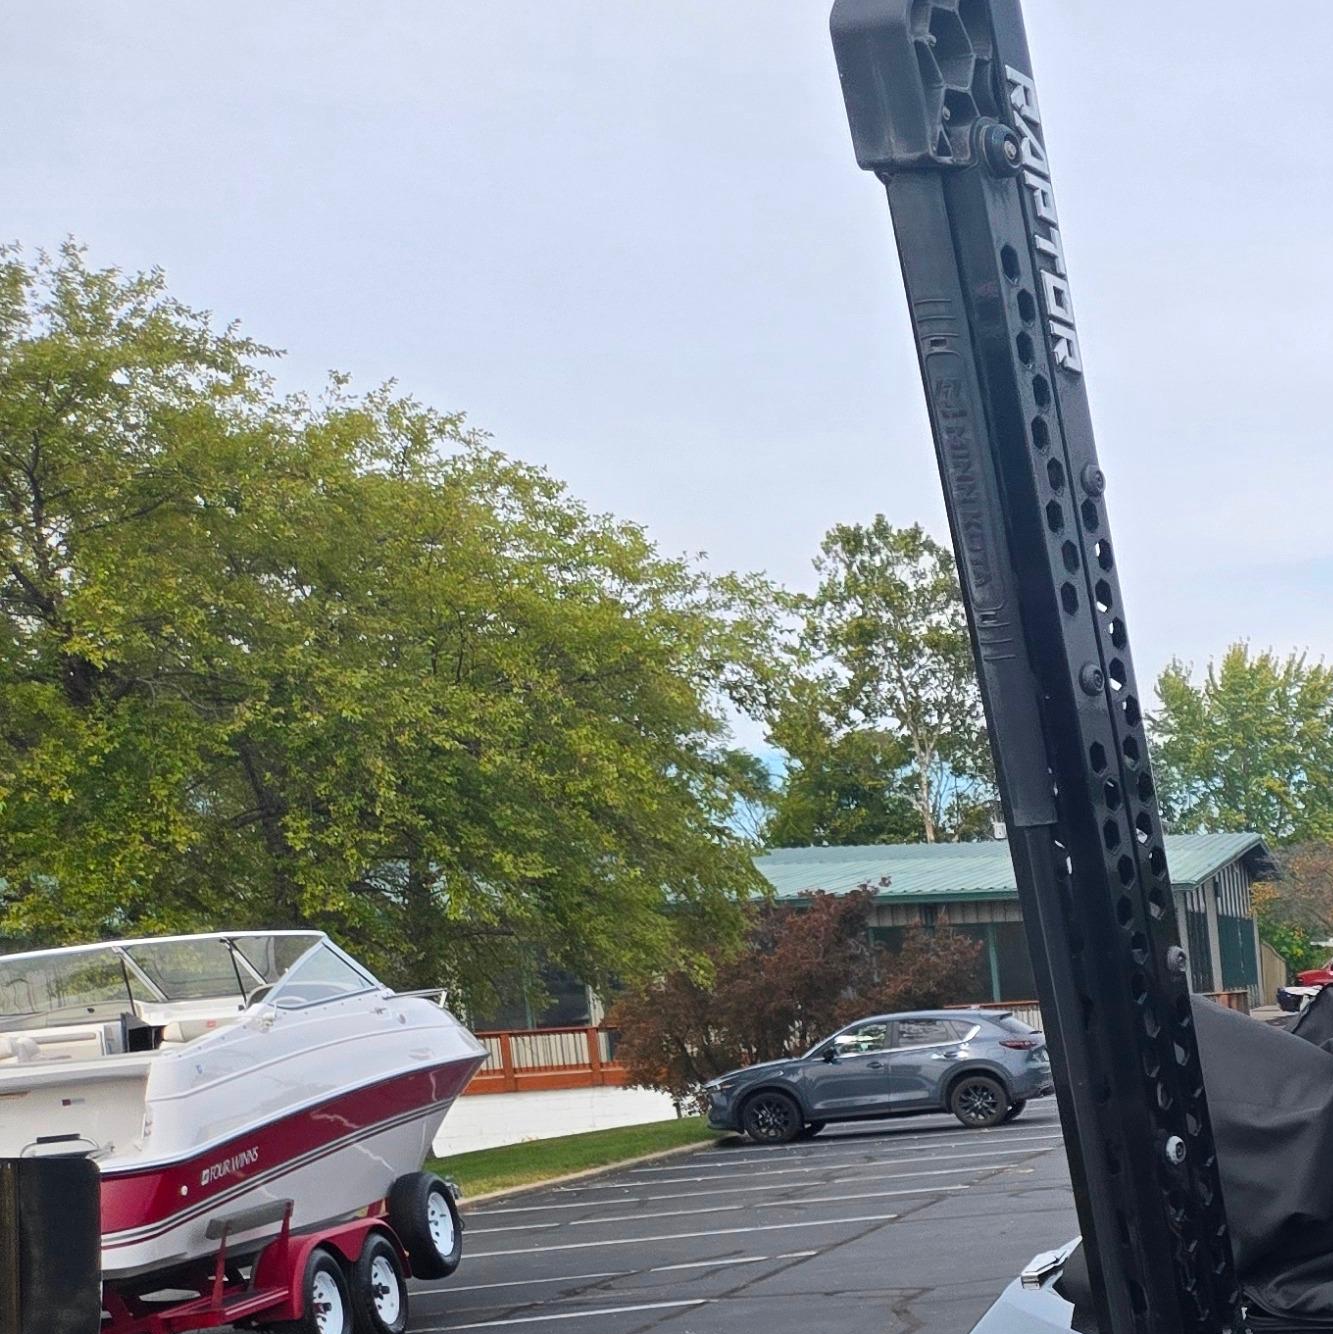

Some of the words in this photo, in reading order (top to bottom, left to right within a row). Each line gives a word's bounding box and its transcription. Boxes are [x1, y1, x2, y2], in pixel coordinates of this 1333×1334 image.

[1005, 64, 1082, 376] RAPTOR
[210, 1158, 231, 1182] FOUR
[232, 1146, 259, 1171] WINNS
